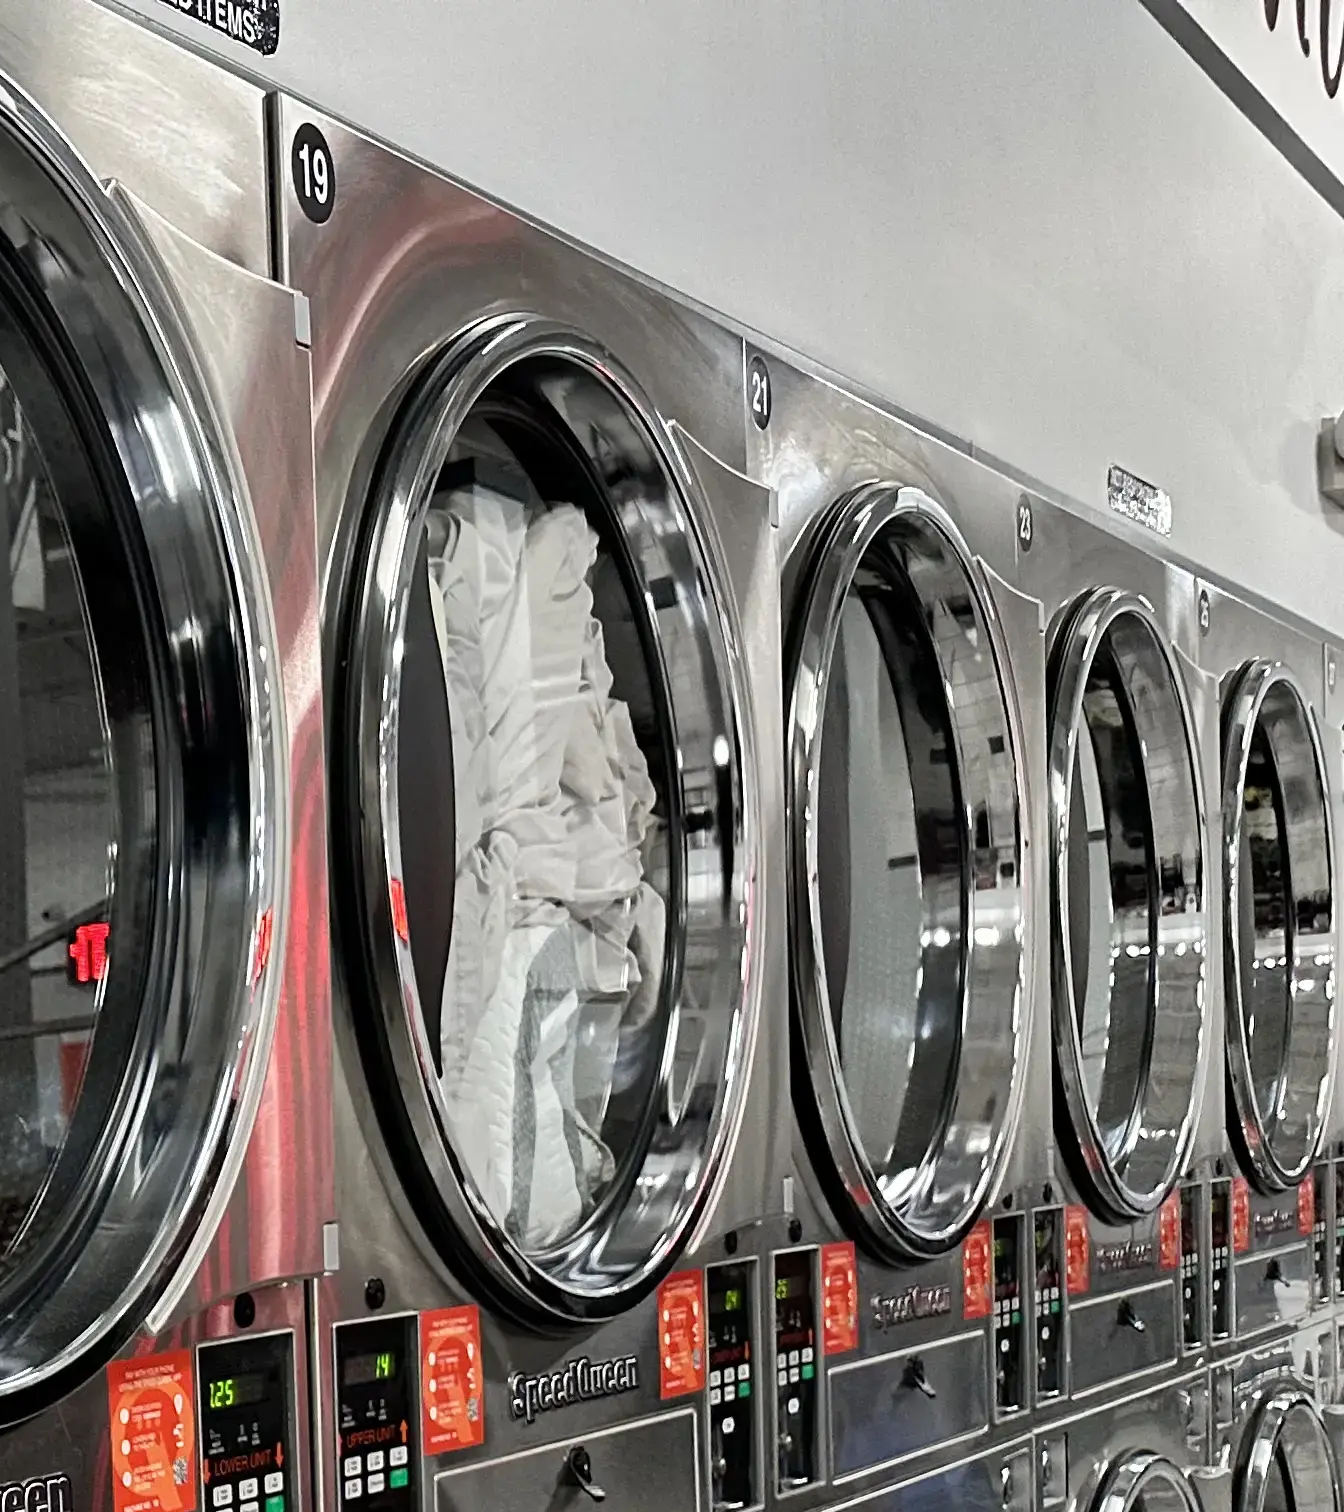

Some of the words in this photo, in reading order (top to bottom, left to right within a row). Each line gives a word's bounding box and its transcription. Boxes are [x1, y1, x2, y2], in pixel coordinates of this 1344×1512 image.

[299, 143, 329, 204] 19
[752, 371, 768, 416] 21
[1019, 506, 1030, 541] 23
[214, 1456, 249, 1477] LOWER
